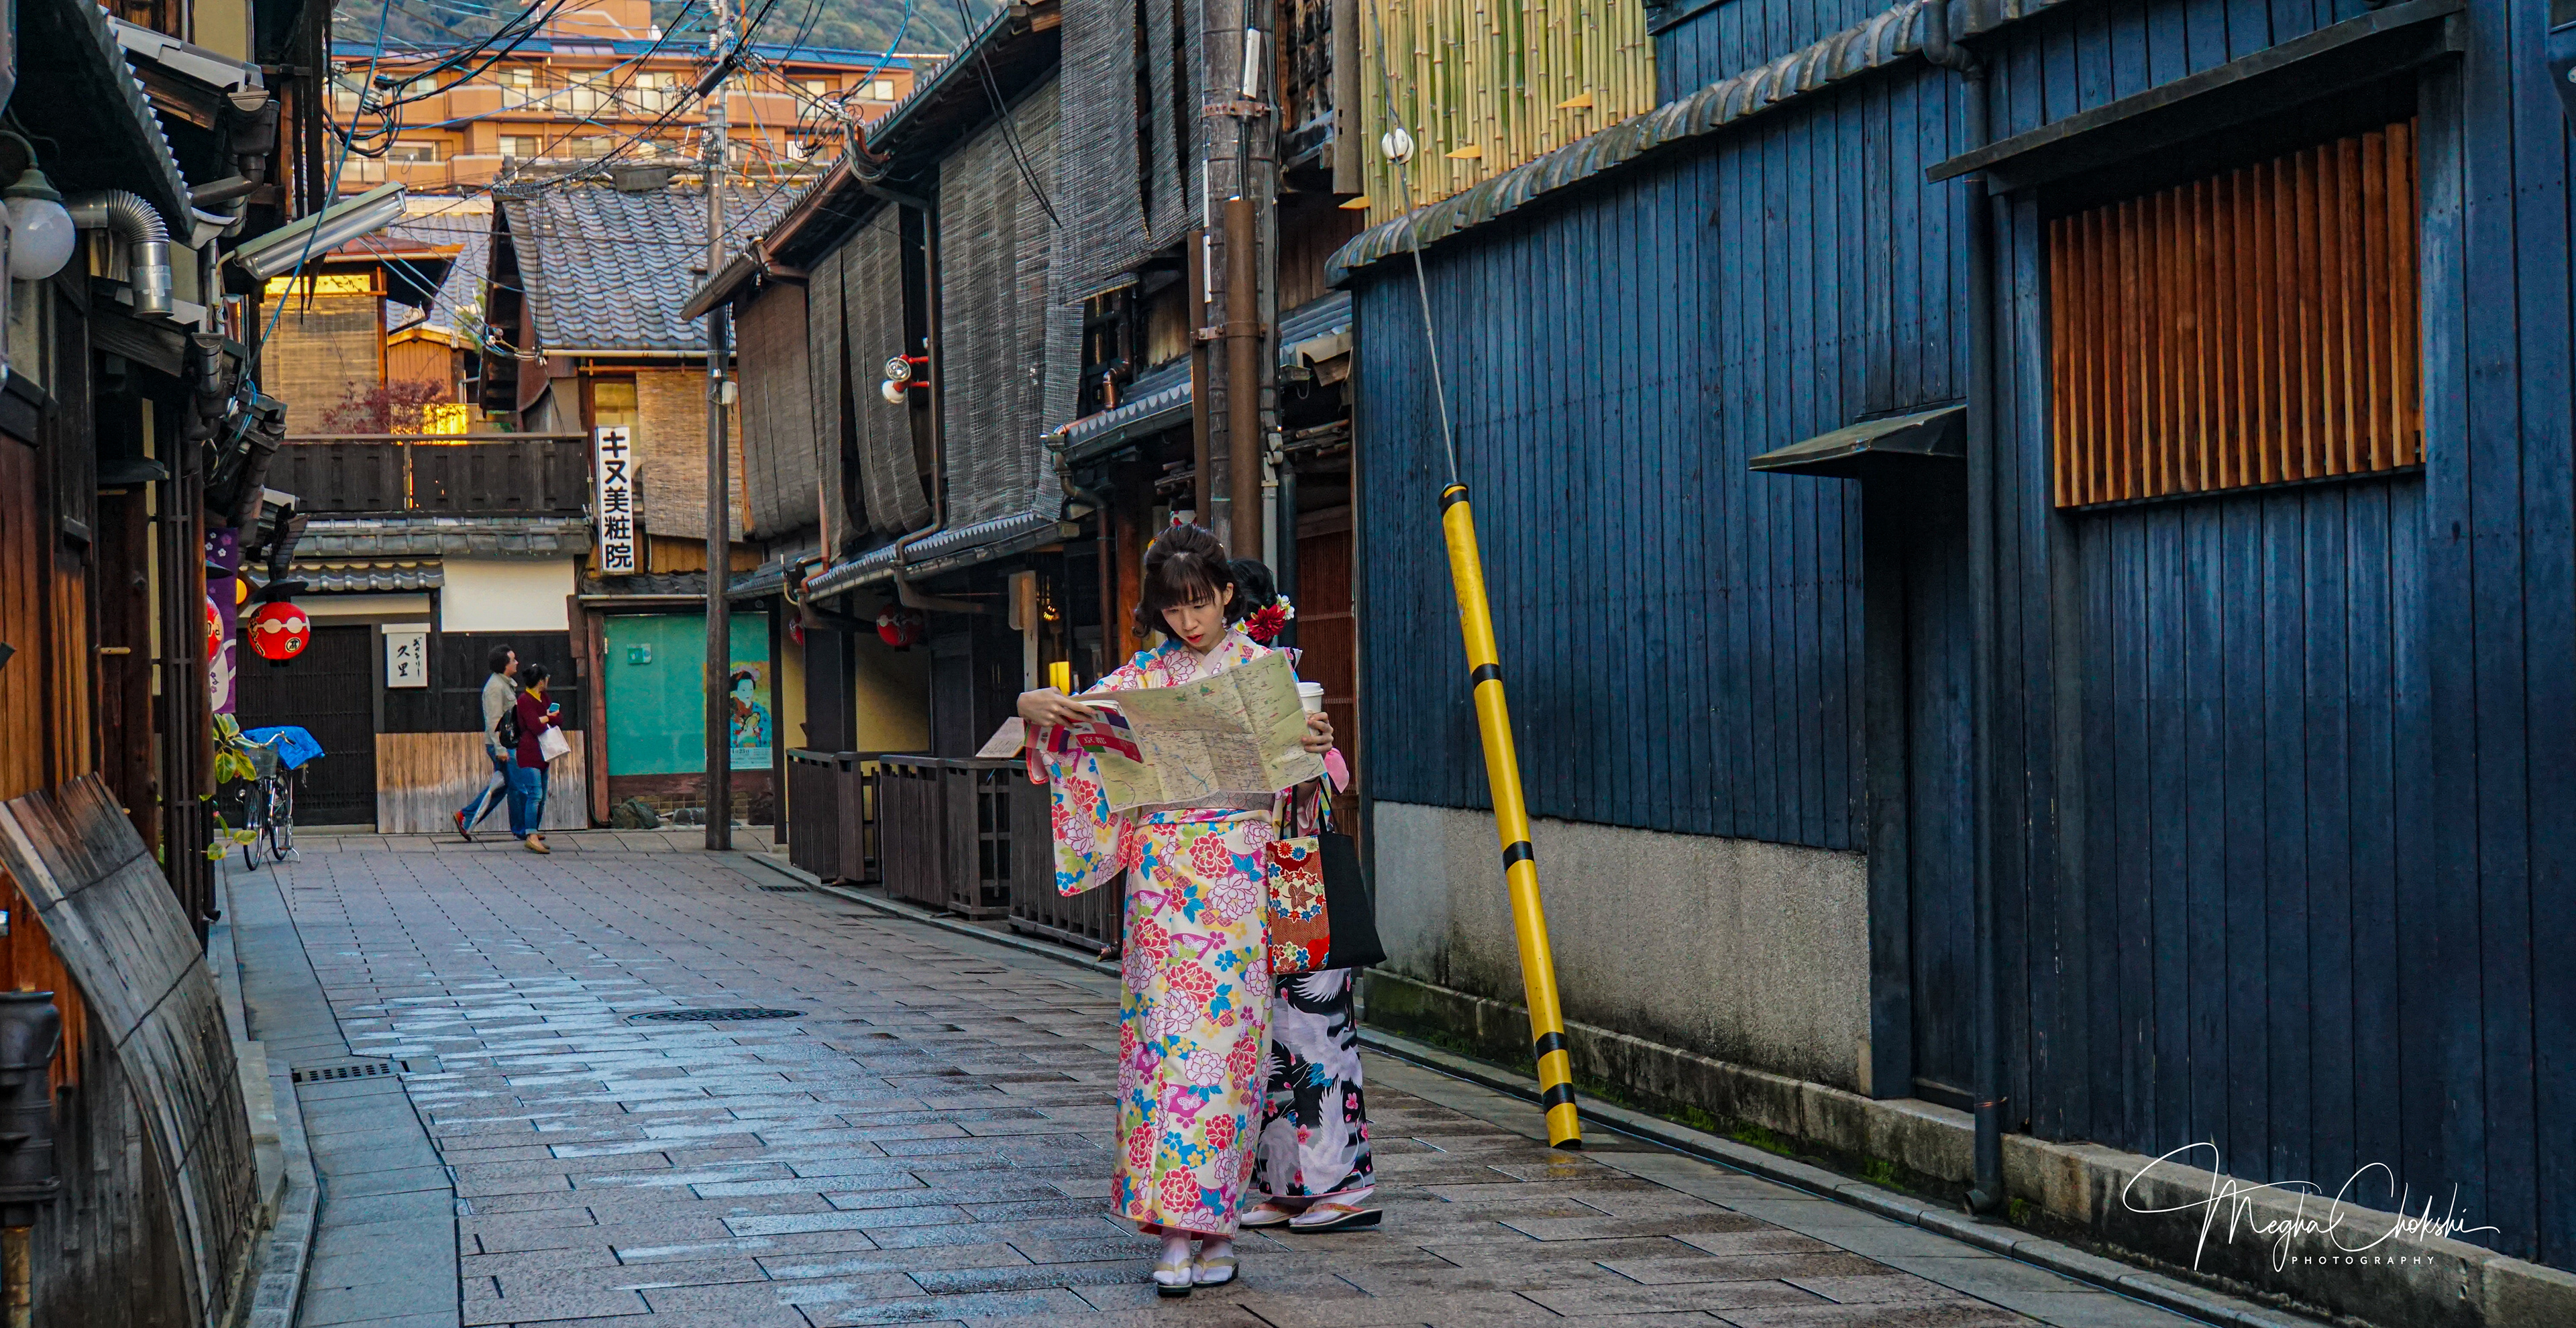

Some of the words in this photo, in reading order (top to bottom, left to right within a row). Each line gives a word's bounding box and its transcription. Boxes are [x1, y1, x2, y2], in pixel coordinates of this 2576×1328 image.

[601, 431, 633, 569] キヌ美粧院
[397, 645, 410, 677] 久里
[1083, 736, 1107, 744] 京都
